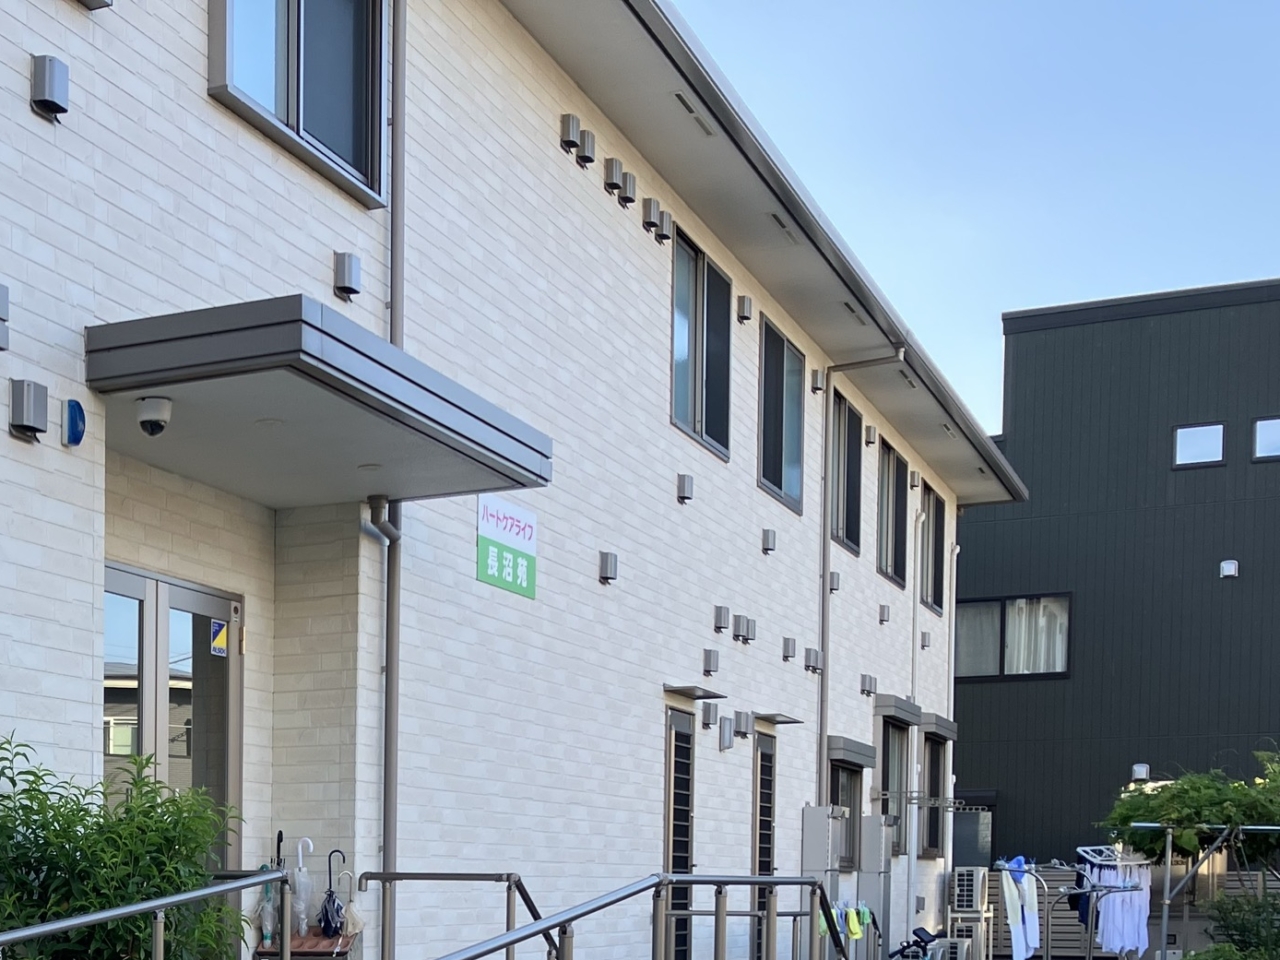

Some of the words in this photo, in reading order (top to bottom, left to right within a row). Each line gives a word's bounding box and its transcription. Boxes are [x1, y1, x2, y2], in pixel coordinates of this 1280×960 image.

[482, 505, 534, 541] ハートケアライフ
[487, 546, 528, 587] 長沼苑
